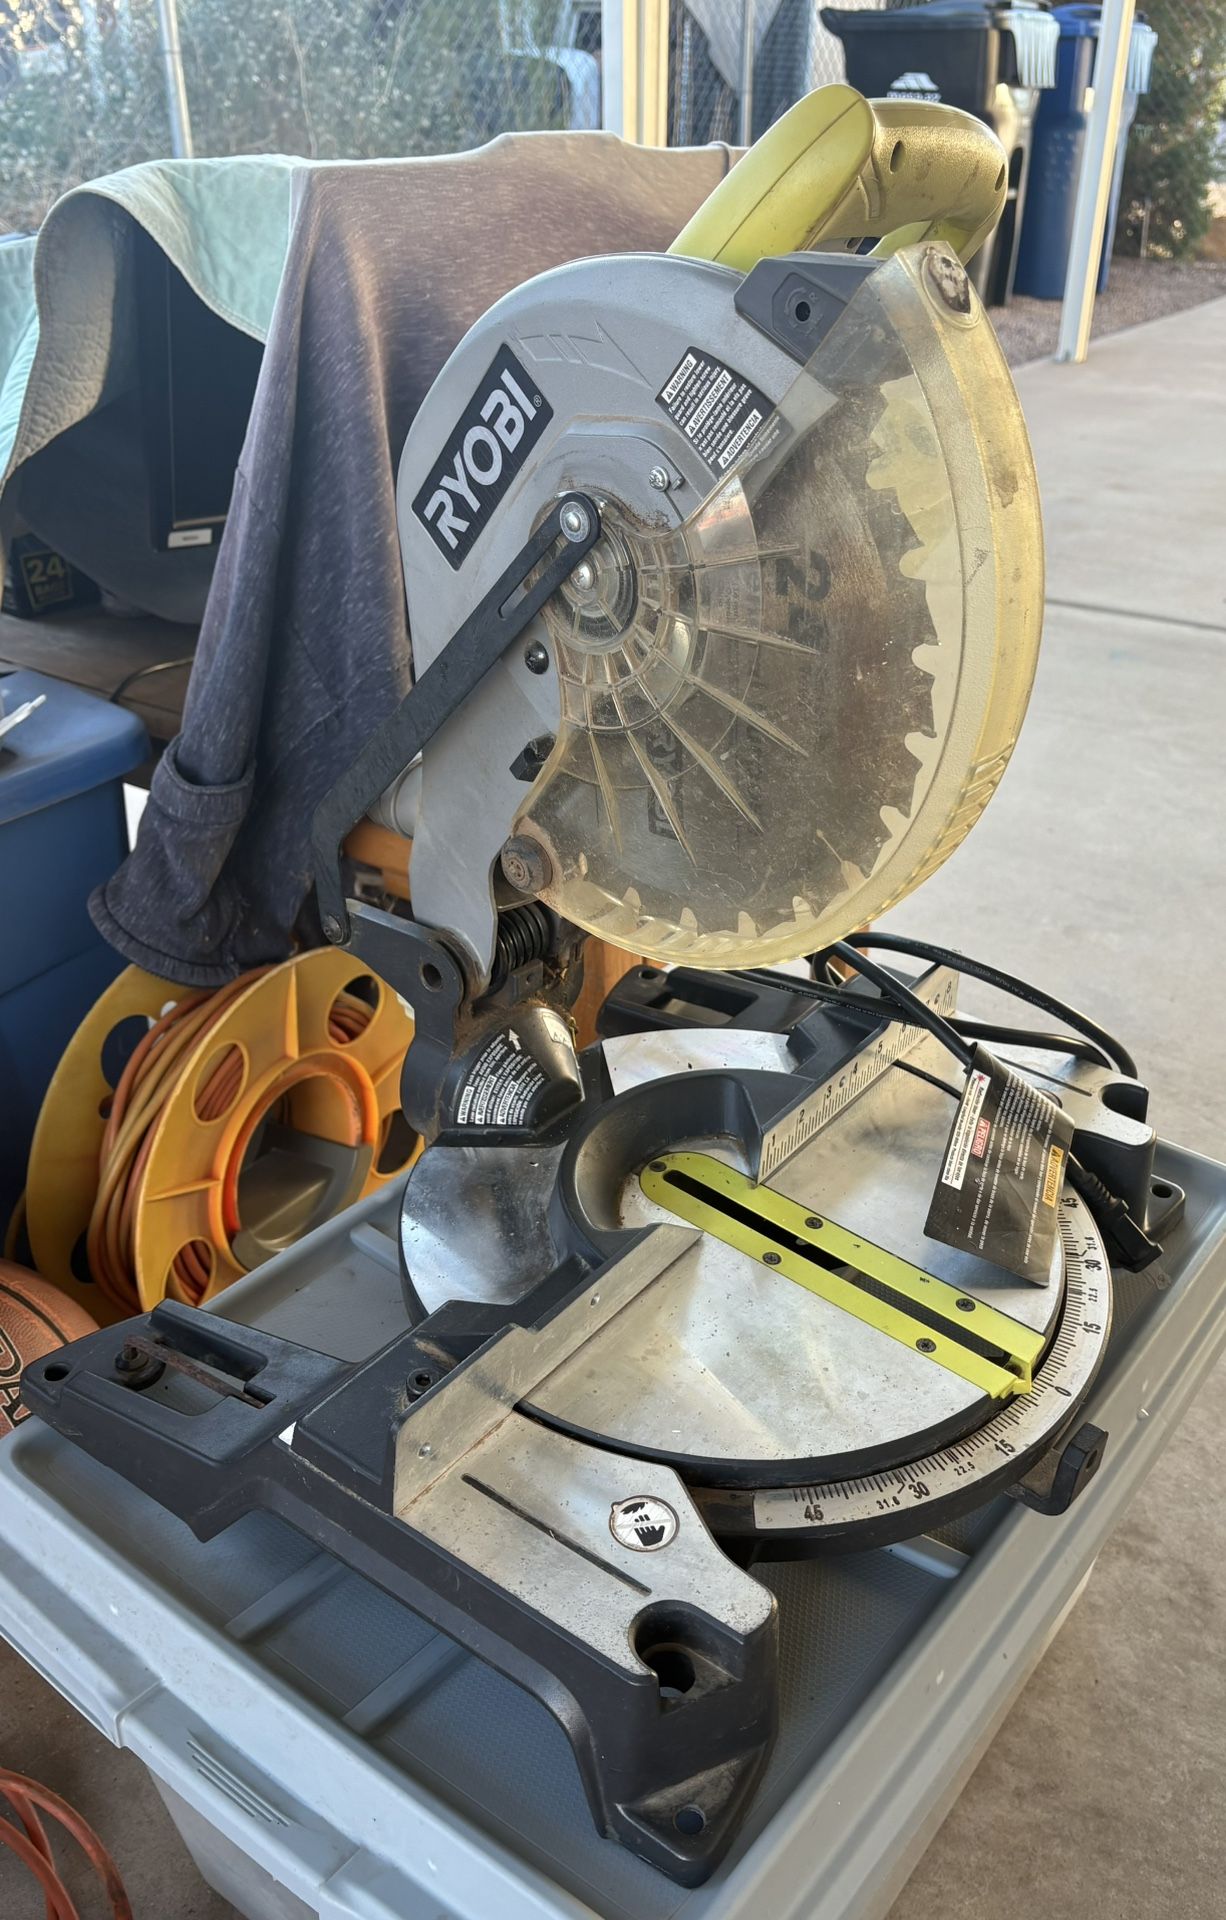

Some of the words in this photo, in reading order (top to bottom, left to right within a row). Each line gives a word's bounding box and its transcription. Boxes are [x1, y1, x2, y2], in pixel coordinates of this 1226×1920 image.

[669, 358, 693, 393] WARNING
[668, 394, 682, 414] Failure
[693, 359, 705, 375] lower
[691, 373, 729, 427] AVERTISSEMENT
[727, 413, 760, 463] ADVERTENCIA
[424, 368, 537, 550] RYOBI
[26, 555, 65, 583] 24
[826, 1085, 832, 1098] 3
[799, 1109, 805, 1122] 2
[972, 1126, 986, 1154] PELIGRO
[1044, 1156, 1059, 1201] ADVERTENCIA
[1063, 1197, 1078, 1208] 45
[1084, 1259, 1102, 1271] 30
[1082, 1321, 1101, 1335] 15
[1054, 1386, 1072, 1397] 0
[995, 1442, 1016, 1459] 15
[954, 1461, 975, 1476] 22.5
[908, 1481, 930, 1499] 30
[876, 1496, 901, 1510] 31.6
[804, 1505, 824, 1521] 45
